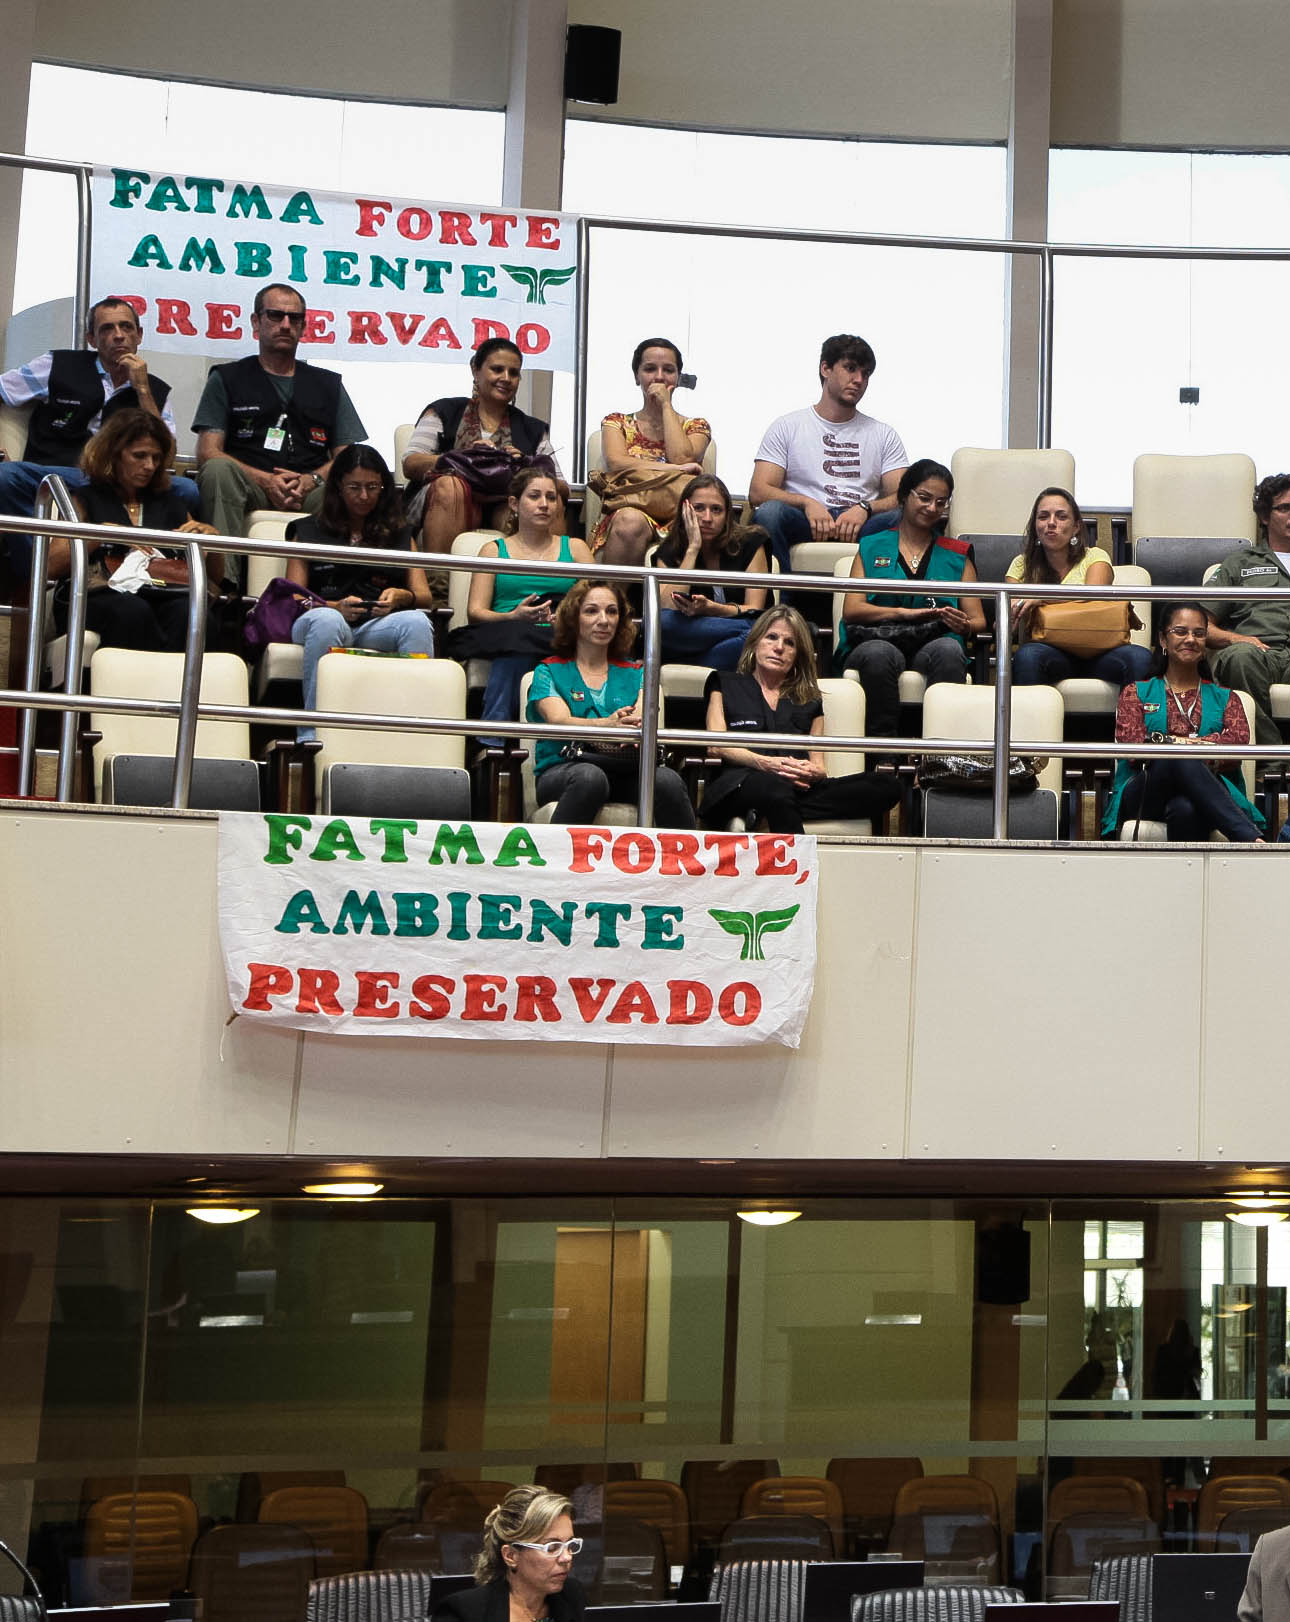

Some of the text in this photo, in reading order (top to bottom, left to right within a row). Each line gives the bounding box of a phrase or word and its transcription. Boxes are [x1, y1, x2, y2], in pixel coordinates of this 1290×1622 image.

[109, 168, 560, 250] FATMA FORTE
[128, 234, 498, 298] AMBIENTE
[106, 295, 551, 355] REERVADO
[264, 815, 810, 885] FATMA FORTE,
[273, 889, 685, 950] AMBIENTE
[242, 963, 762, 1026] PRESERVADO
